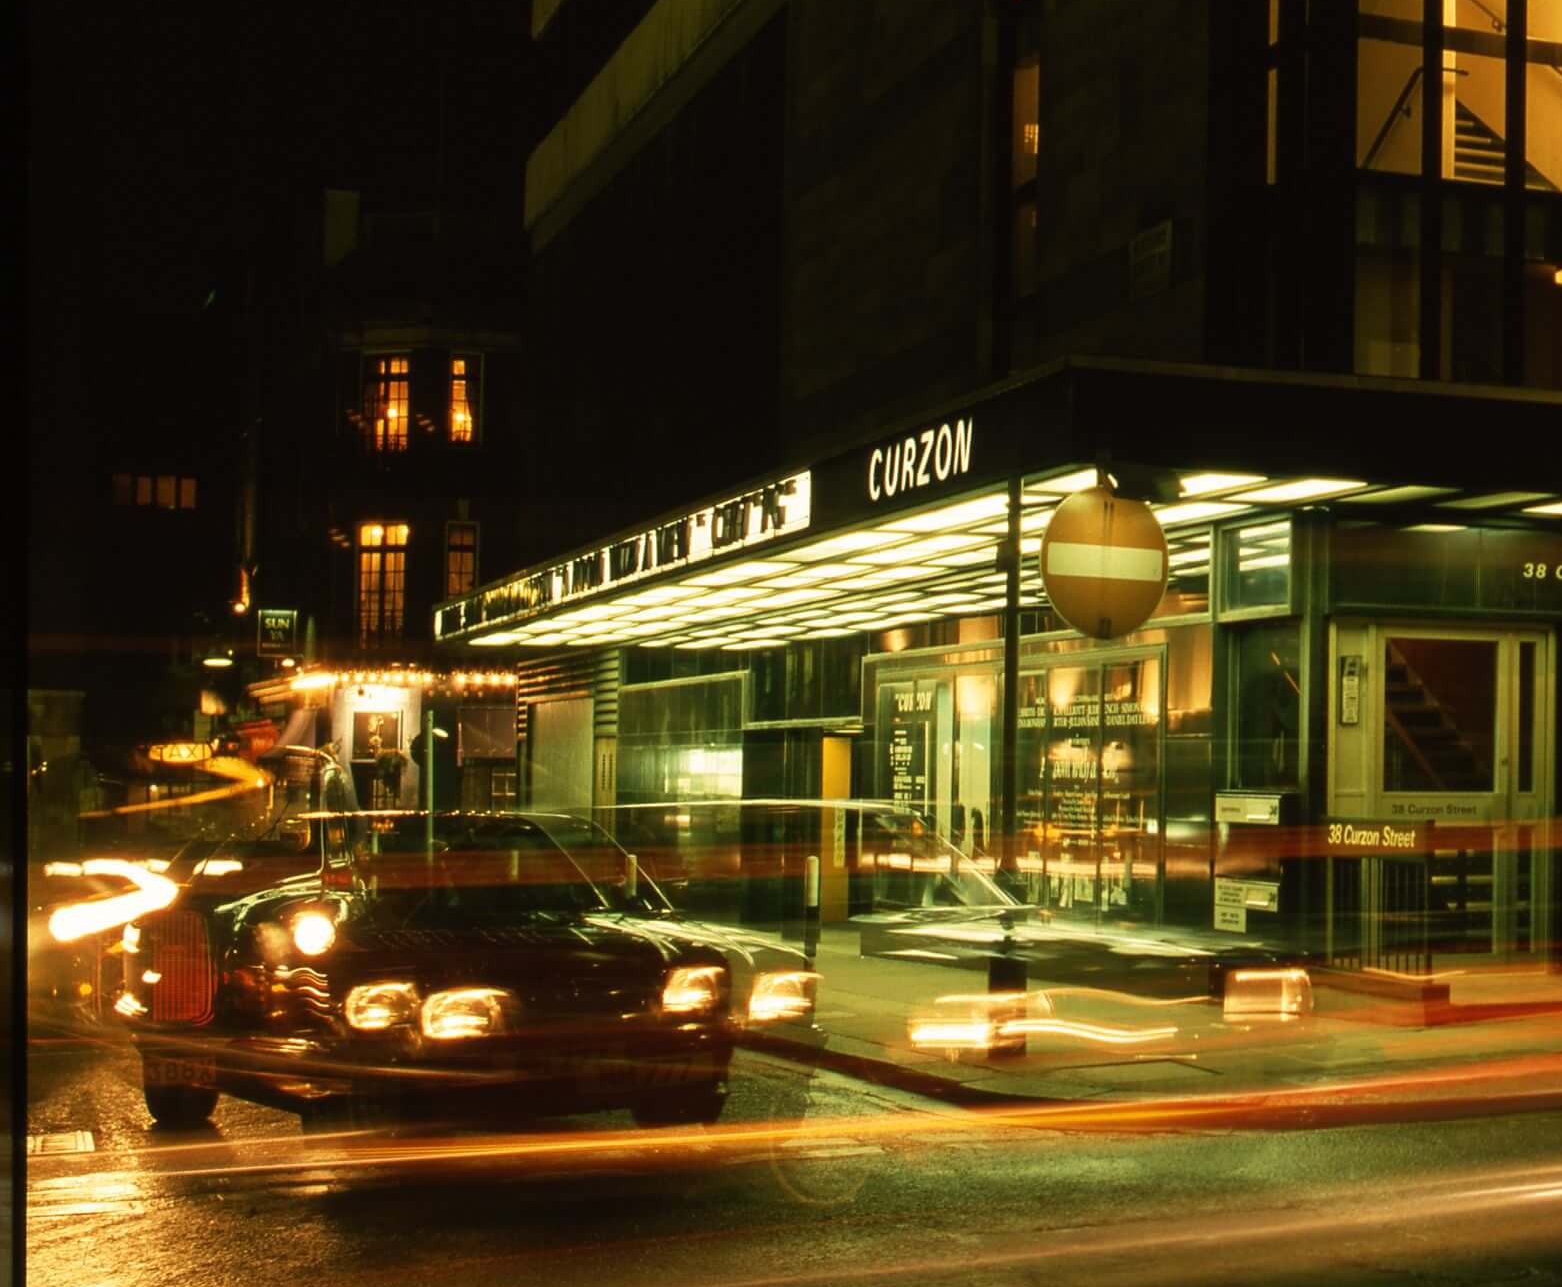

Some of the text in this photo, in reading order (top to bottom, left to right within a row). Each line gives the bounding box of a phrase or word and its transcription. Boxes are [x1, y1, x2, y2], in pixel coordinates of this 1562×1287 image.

[869, 416, 974, 502] CURZON
[1522, 562, 1547, 580] 38
[264, 616, 290, 630] SUN
[154, 743, 207, 761] TAXI
[1408, 804, 1443, 815] Curzon
[1446, 804, 1477, 815] Street
[1328, 823, 1417, 848] 38 Curzon Street
